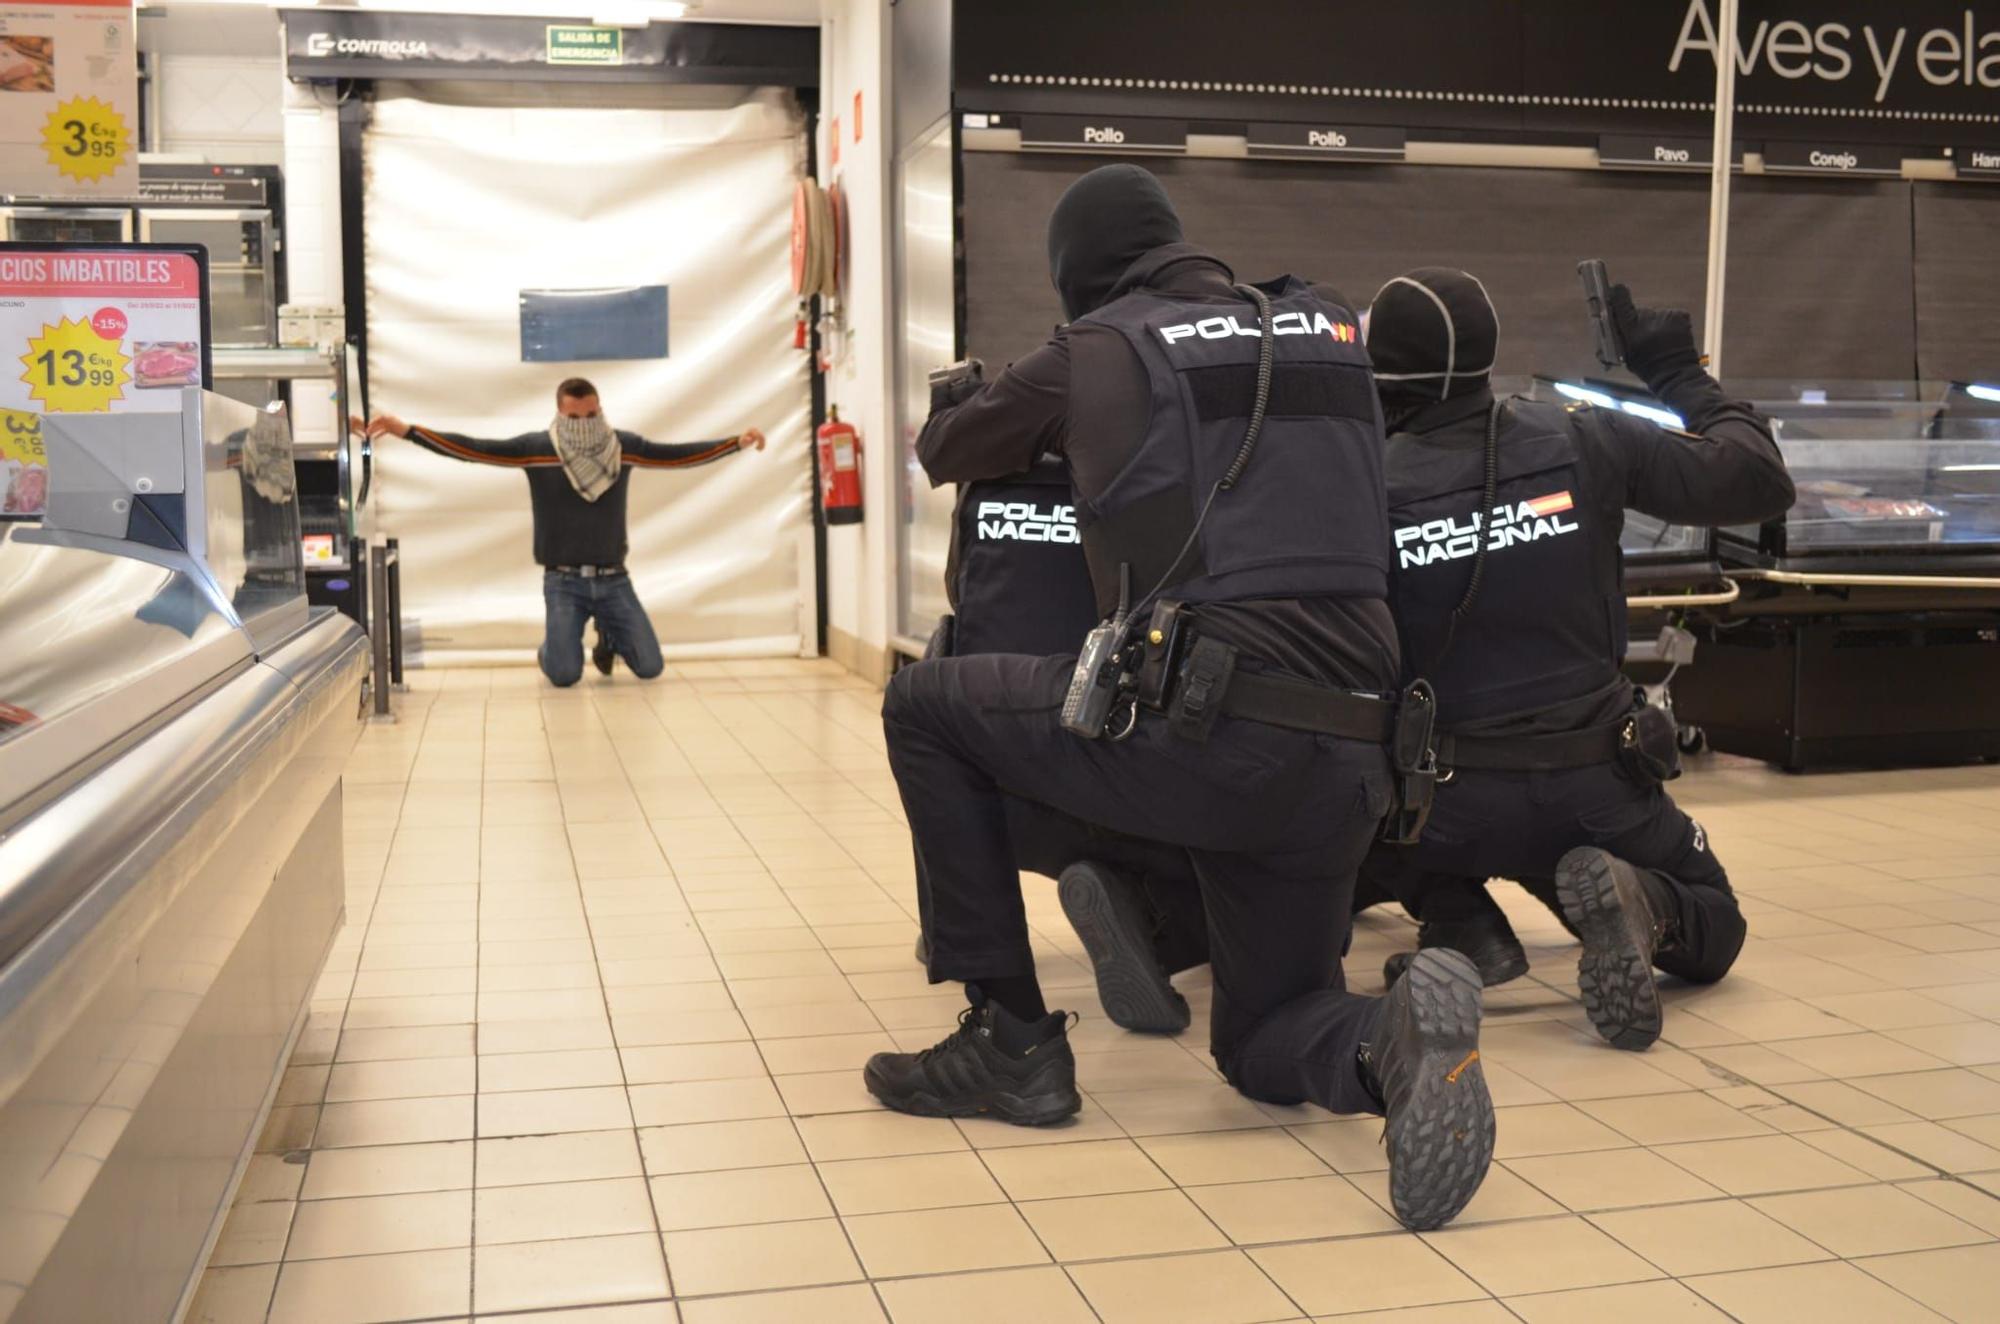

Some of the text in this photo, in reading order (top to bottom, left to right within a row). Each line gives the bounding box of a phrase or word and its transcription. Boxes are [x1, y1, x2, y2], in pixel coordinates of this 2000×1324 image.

[337, 38, 428, 54] CONTROLSA
[557, 32, 611, 44] SALIDA DE
[551, 47, 618, 58] EMERGENCIA
[1668, 0, 2000, 103] Aves y ela
[63, 119, 88, 157] 3
[91, 140, 116, 158] 95
[1084, 126, 1124, 144] Pollo
[1308, 130, 1347, 148] Pollo
[1655, 146, 1689, 162] Pavo
[1810, 150, 1857, 169] Conejo
[1, 258, 170, 283] CIOS IMBATIBLES
[94, 317, 126, 331] -15%
[1160, 312, 1337, 344] POLCIA
[37, 349, 87, 386] 13
[89, 369, 114, 386] 99
[978, 520, 1081, 544] NACIO
